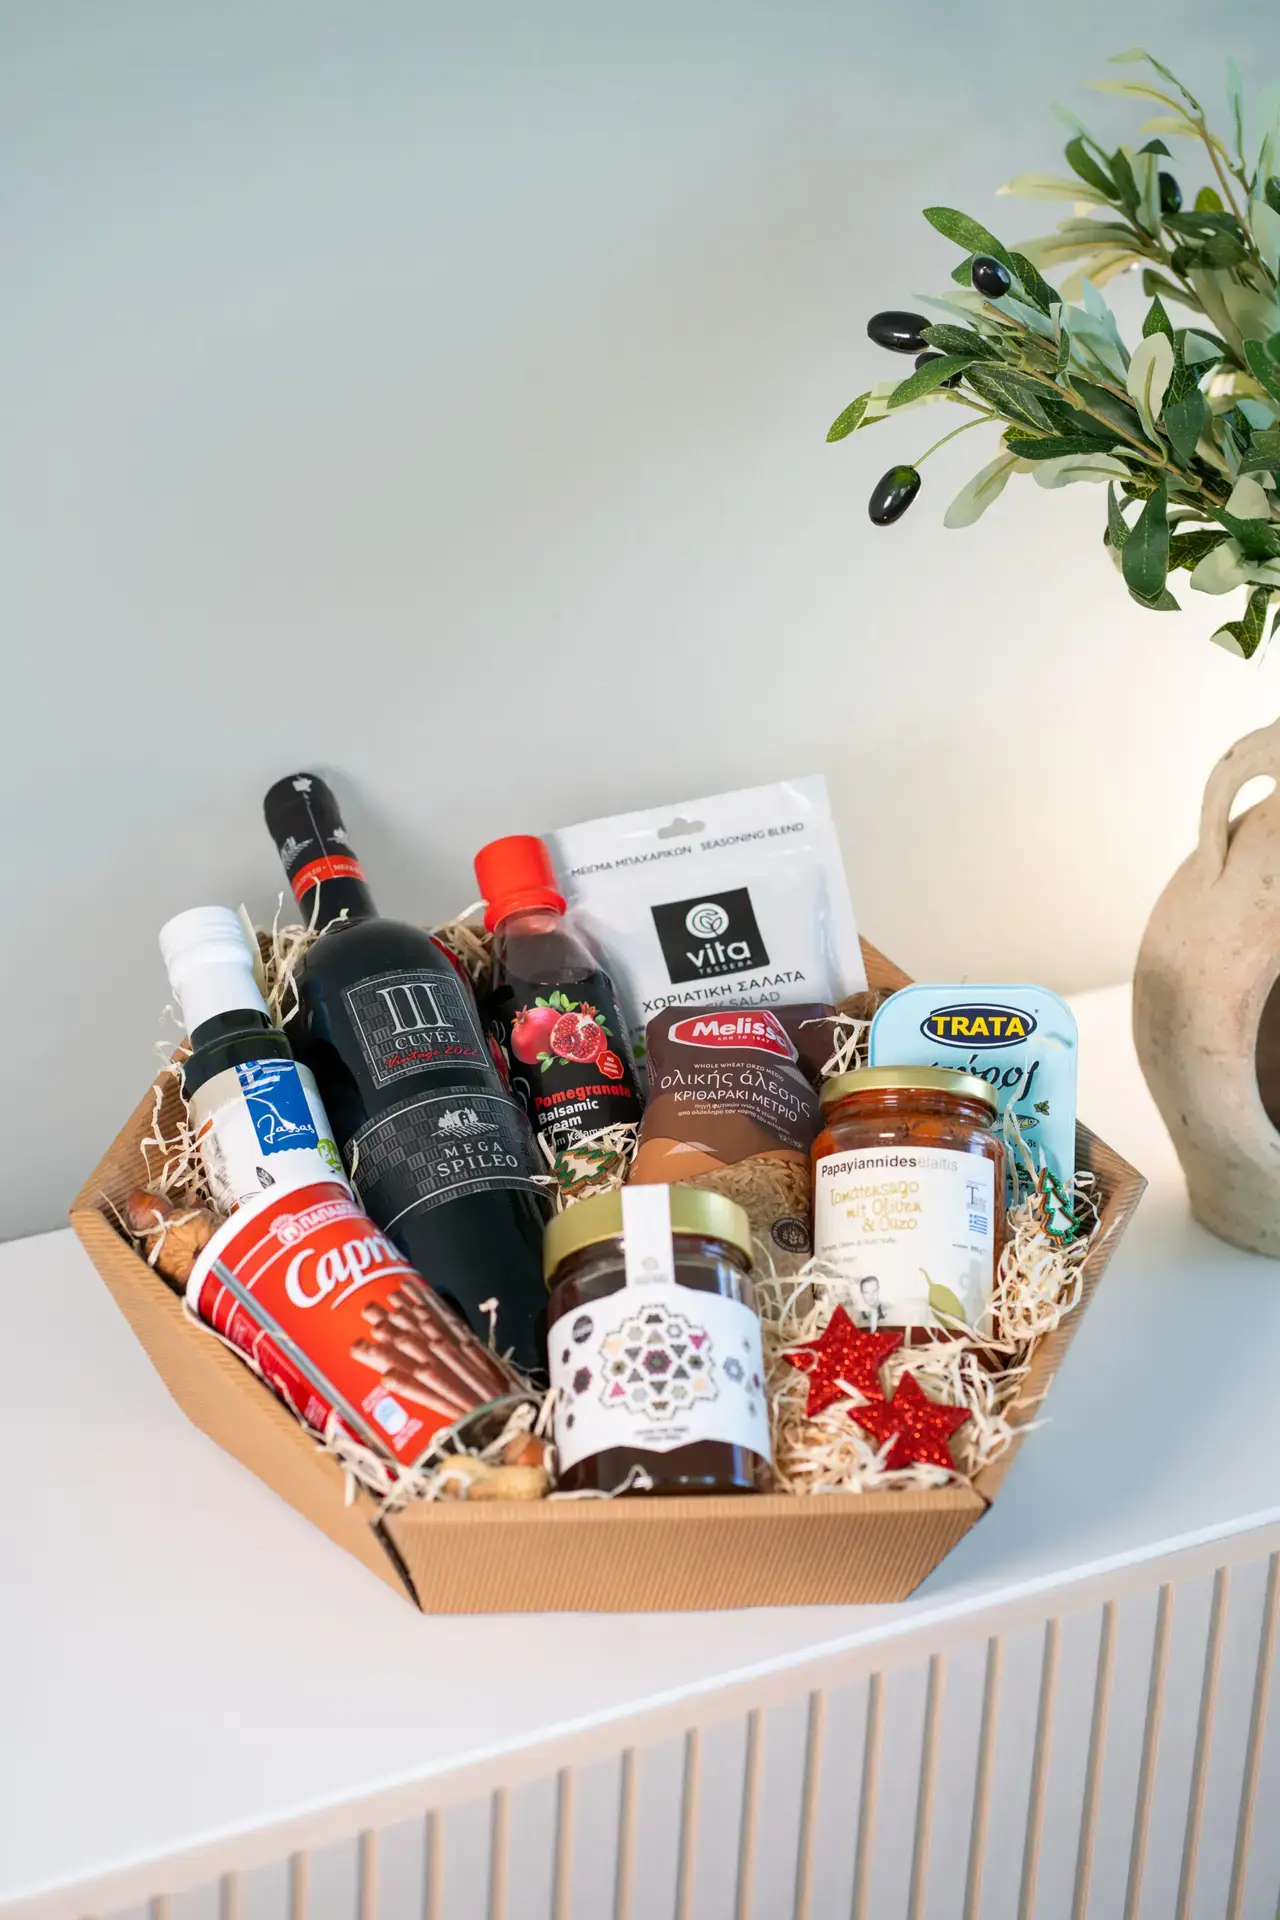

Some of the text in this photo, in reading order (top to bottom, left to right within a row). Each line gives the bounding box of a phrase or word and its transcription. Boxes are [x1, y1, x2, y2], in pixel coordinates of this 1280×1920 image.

[700, 822, 804, 851] SEASONING BLEND
[571, 845, 692, 877] ΜΕΙΓΜΑ ΜΠΑΧΑΡΙΚΩΝ
[686, 940, 752, 968] vita
[699, 960, 753, 975] TESSERA
[642, 971, 806, 1014] ΧΩΡΙΑΤΙΚΗ ΣΑΛΑΤΑ
[729, 991, 781, 1007] SALAD
[931, 1016, 1026, 1037] TRATA
[395, 1029, 460, 1050] CUVÉE
[385, 1045, 478, 1070] Vintage 2022
[746, 1063, 765, 1071] ORZO
[534, 1084, 632, 1112] Pomegranate
[661, 1069, 810, 1118] ολικής άλεσης
[538, 1099, 600, 1126] Balsamic
[674, 1090, 798, 1122] ΚΡΙΘΑΡΑΚΙ ΜΕΤΡΙΟ
[542, 1115, 582, 1138] cream
[444, 1141, 503, 1158] MEGA
[437, 1154, 518, 1177] SPILEO
[872, 1197, 922, 1217] Oliven
[862, 1217, 918, 1234] & Ouzo
